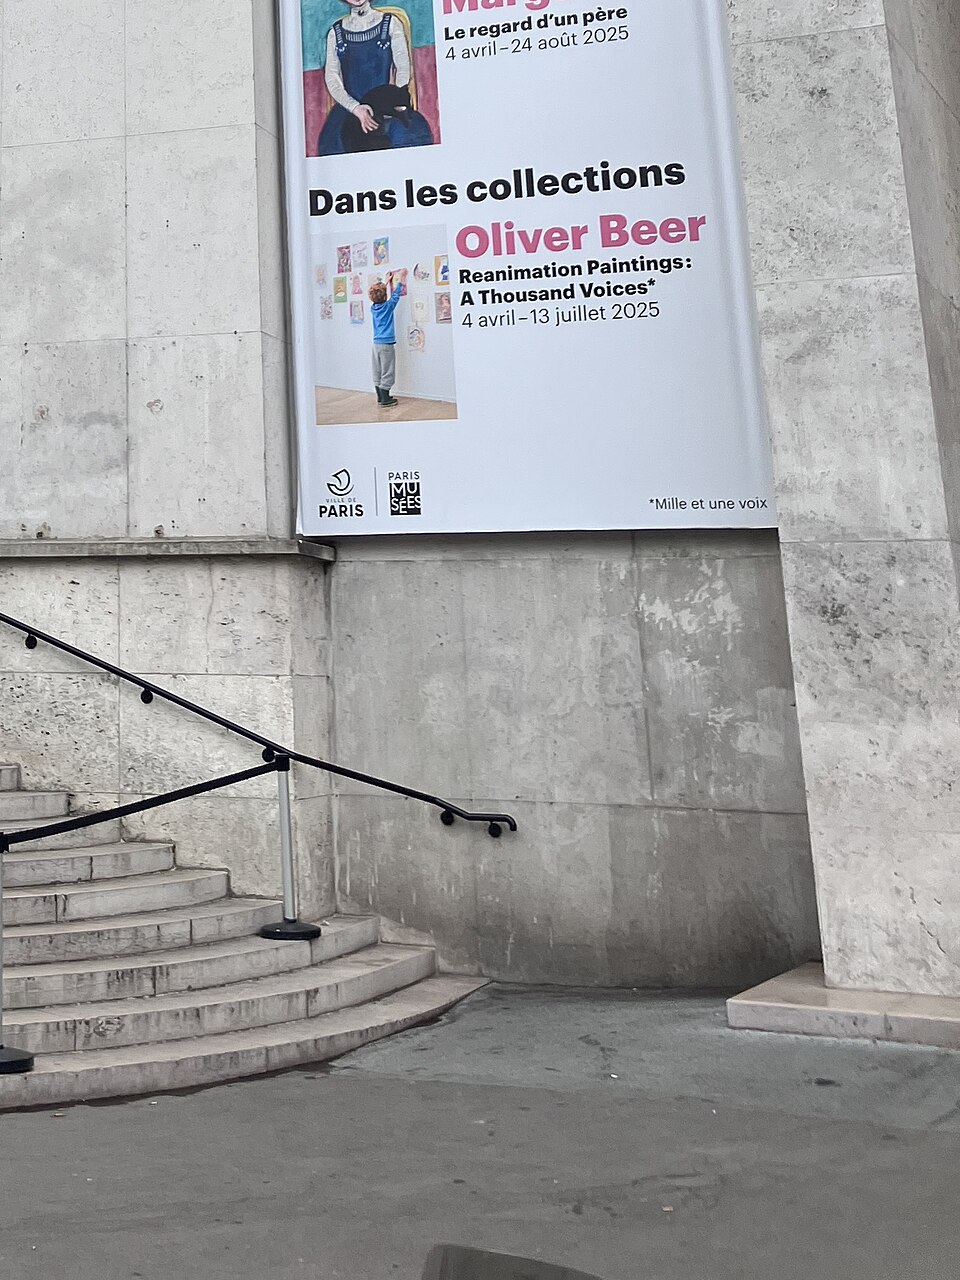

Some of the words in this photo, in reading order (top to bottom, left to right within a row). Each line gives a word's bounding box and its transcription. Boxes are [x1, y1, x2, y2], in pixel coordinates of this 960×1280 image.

[444, 26, 466, 41] Le
[468, 17, 533, 43] regard
[582, 4, 628, 27] père
[446, 46, 457, 61] 4
[538, 31, 579, 49] août
[582, 25, 630, 44] 2025
[309, 188, 397, 216] Dans
[406, 178, 458, 209] les
[466, 160, 686, 203] collections
[455, 221, 589, 259] Oliver
[600, 213, 706, 249] Beer
[459, 262, 583, 284] Reanimation
[587, 255, 692, 276] Paintings:
[460, 291, 474, 306] A
[479, 285, 575, 305] Thousand
[462, 313, 473, 328] 4
[554, 304, 607, 325] juillet
[611, 302, 660, 319] 2025
[388, 472, 419, 480] PARIS
[319, 504, 364, 517] PARIS
[691, 499, 705, 509] et
[709, 500, 734, 509] une
[739, 496, 768, 509] voix
